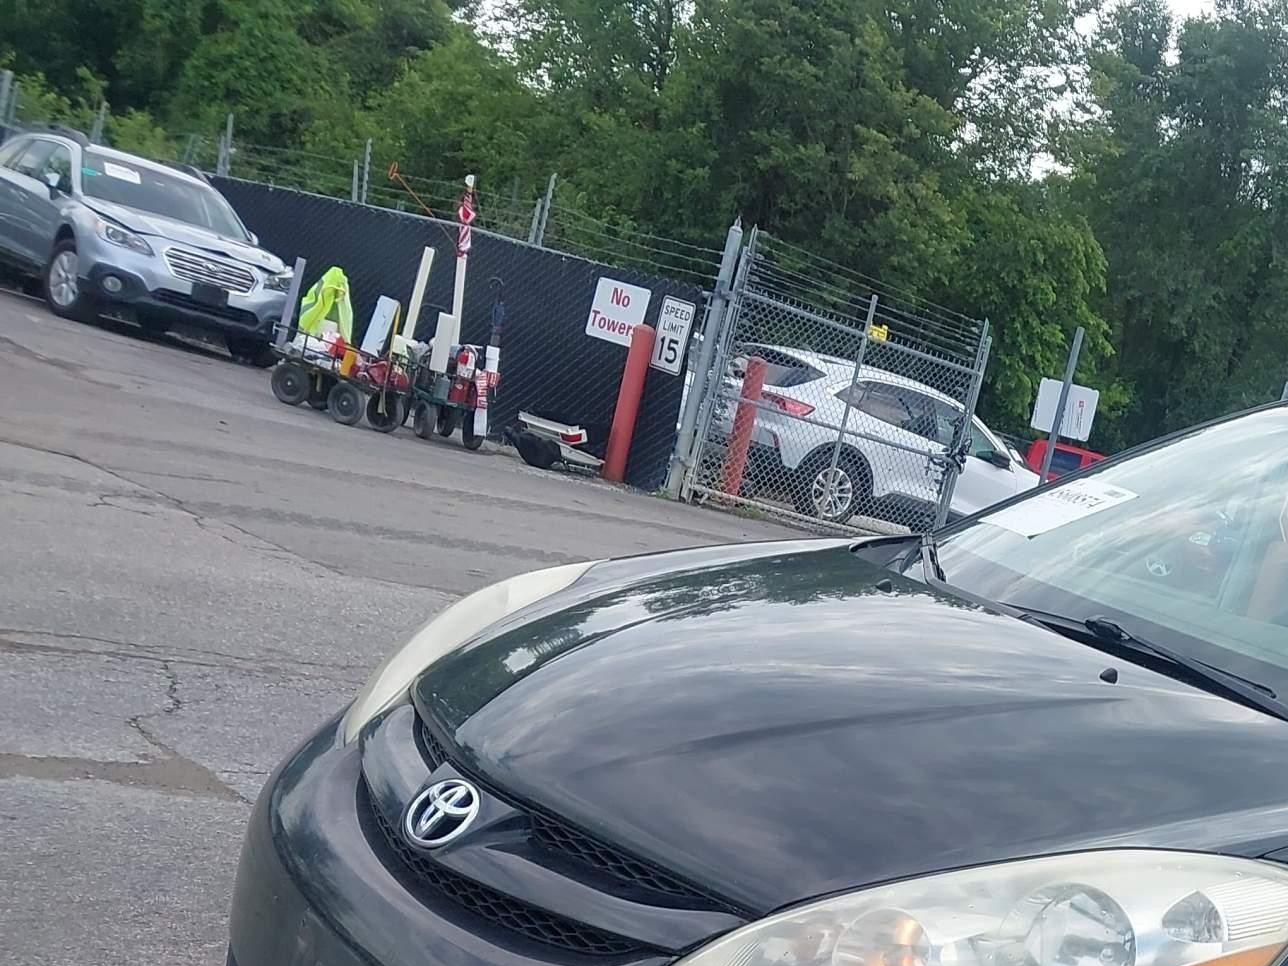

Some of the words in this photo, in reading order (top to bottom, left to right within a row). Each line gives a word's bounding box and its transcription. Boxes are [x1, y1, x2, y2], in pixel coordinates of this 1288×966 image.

[611, 287, 631, 308] No
[592, 309, 634, 337] Tower
[664, 304, 691, 321] SPEED
[662, 319, 685, 335] LIMIT
[658, 336, 679, 364] 15
